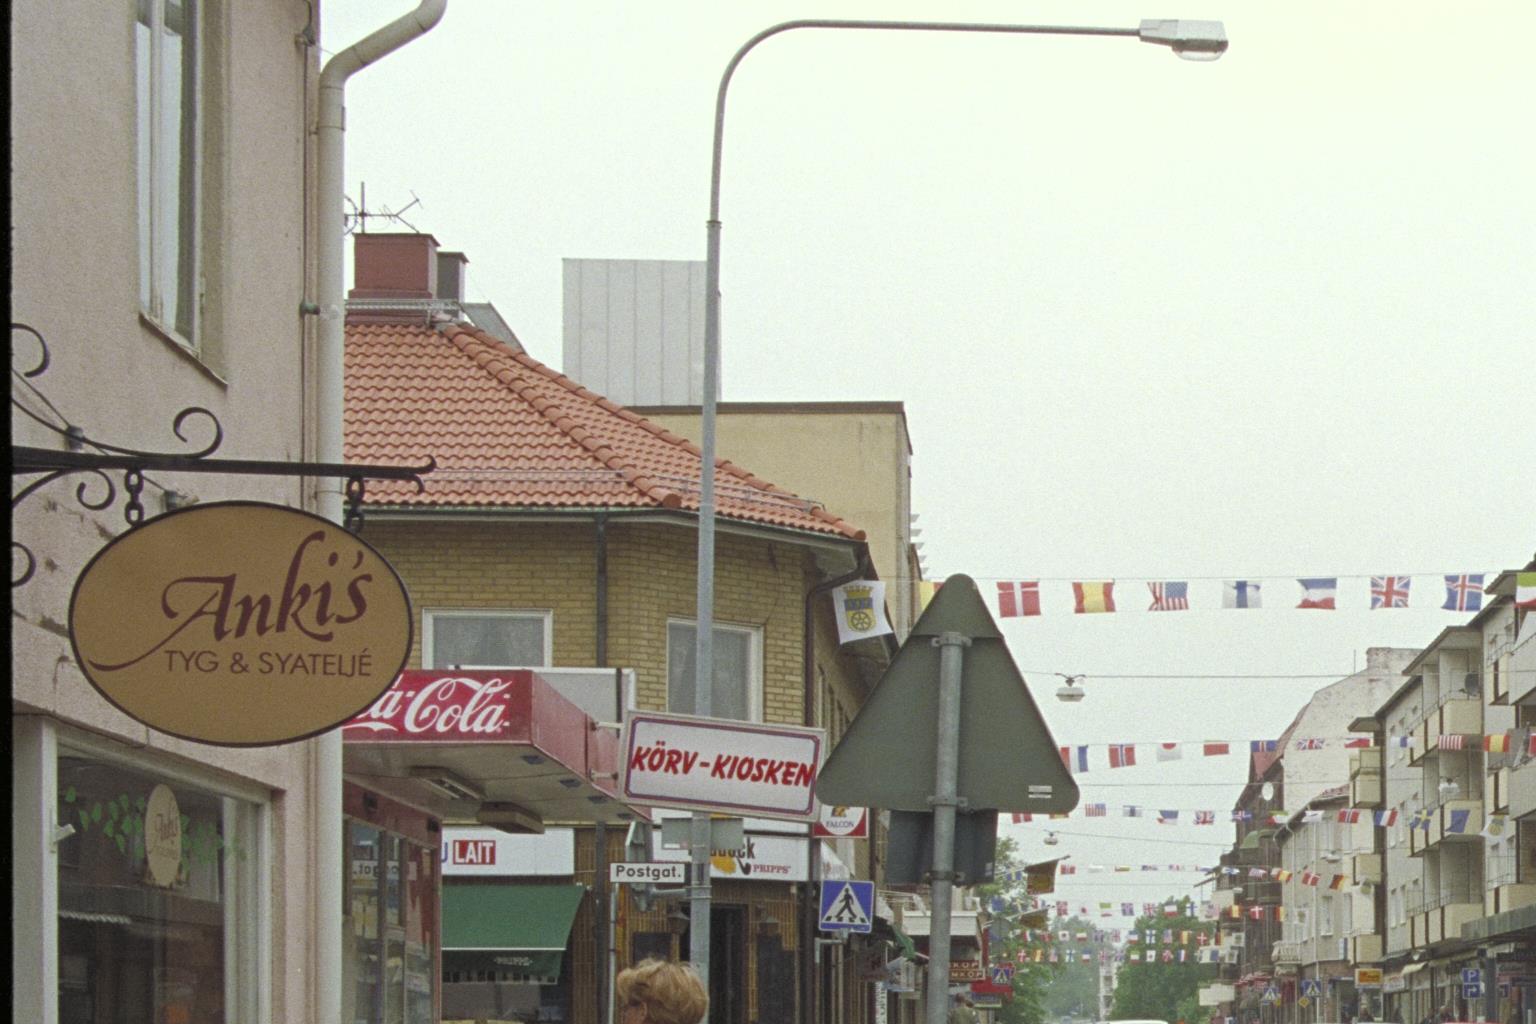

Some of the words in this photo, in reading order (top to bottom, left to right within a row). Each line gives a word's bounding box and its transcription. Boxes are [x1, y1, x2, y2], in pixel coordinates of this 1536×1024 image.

[88, 530, 373, 671] Anki's
[165, 650, 218, 673] TYG
[230, 652, 249, 674] &
[258, 648, 373, 677] SYATELJÉ
[455, 842, 494, 864] LAIT
[615, 864, 683, 882] Postgat.
